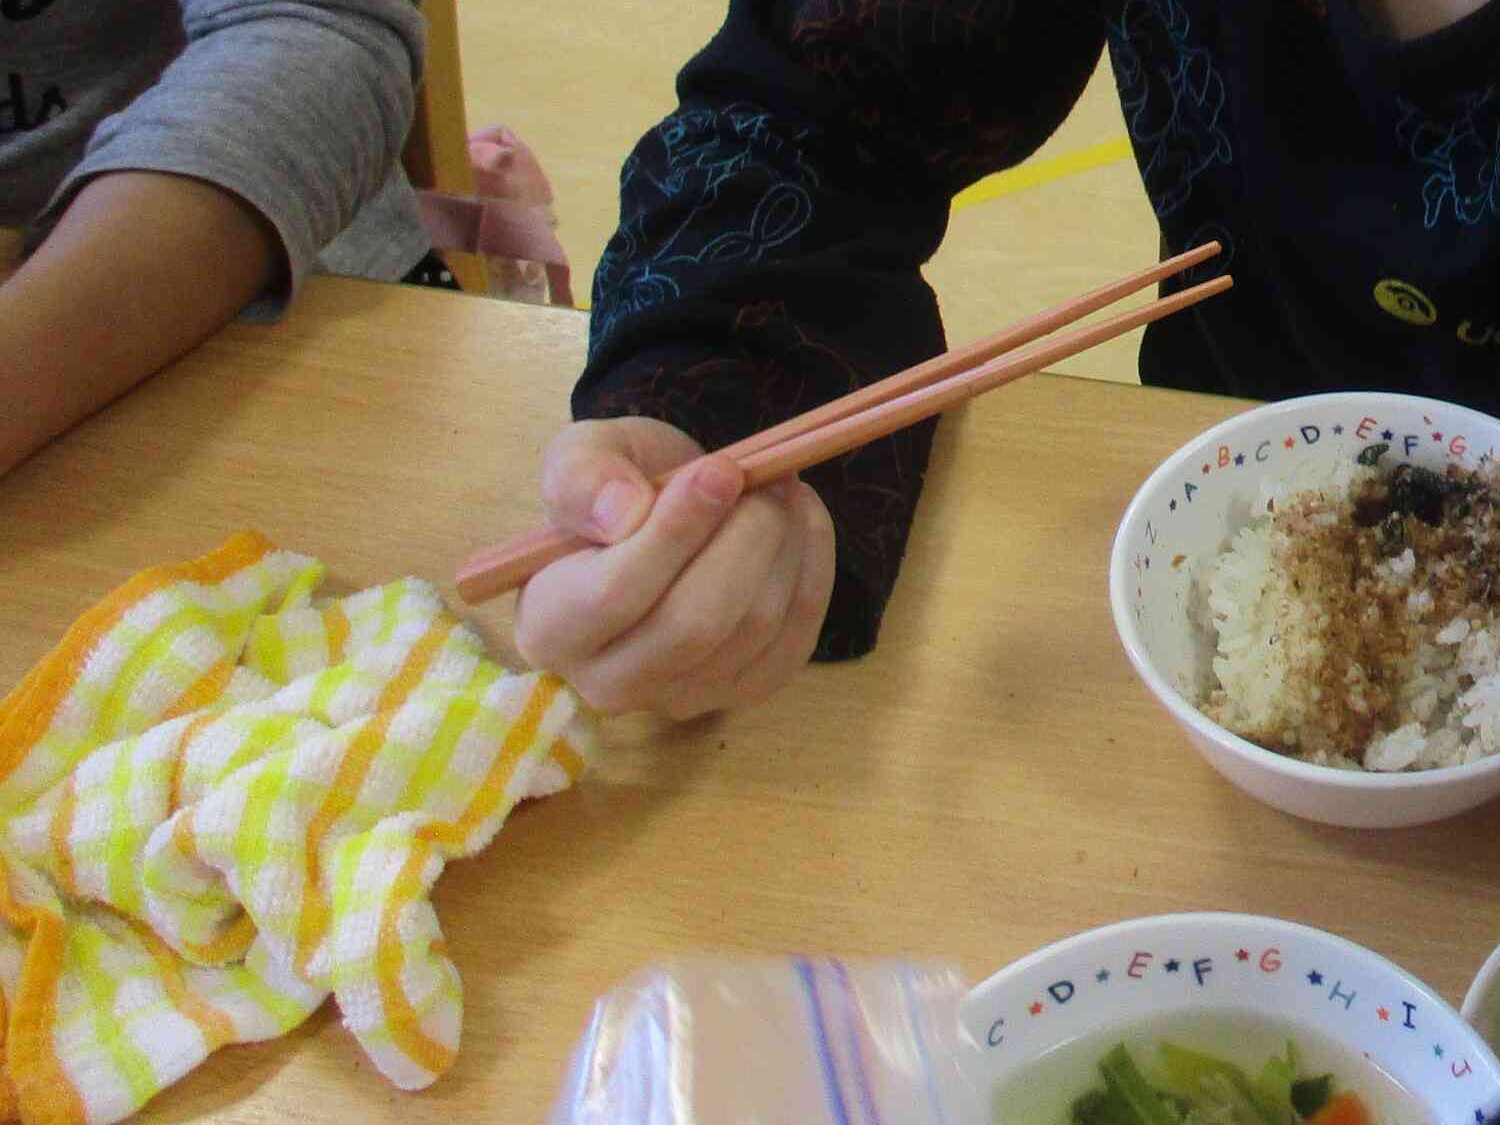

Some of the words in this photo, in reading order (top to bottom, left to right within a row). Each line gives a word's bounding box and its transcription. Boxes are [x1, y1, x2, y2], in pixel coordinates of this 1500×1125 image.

[1217, 446, 1232, 468] B
[1255, 440, 1271, 462] C
[1301, 425, 1320, 445] D
[1355, 416, 1378, 440] E
[1403, 434, 1419, 457] F
[1449, 434, 1467, 456] G
[987, 1018, 1004, 1047] C
[1048, 980, 1075, 1005] D
[1127, 952, 1152, 978] E
[1193, 958, 1213, 984] F
[1258, 948, 1282, 972] G
[1328, 981, 1357, 1010] H
[1402, 1001, 1417, 1029] I
